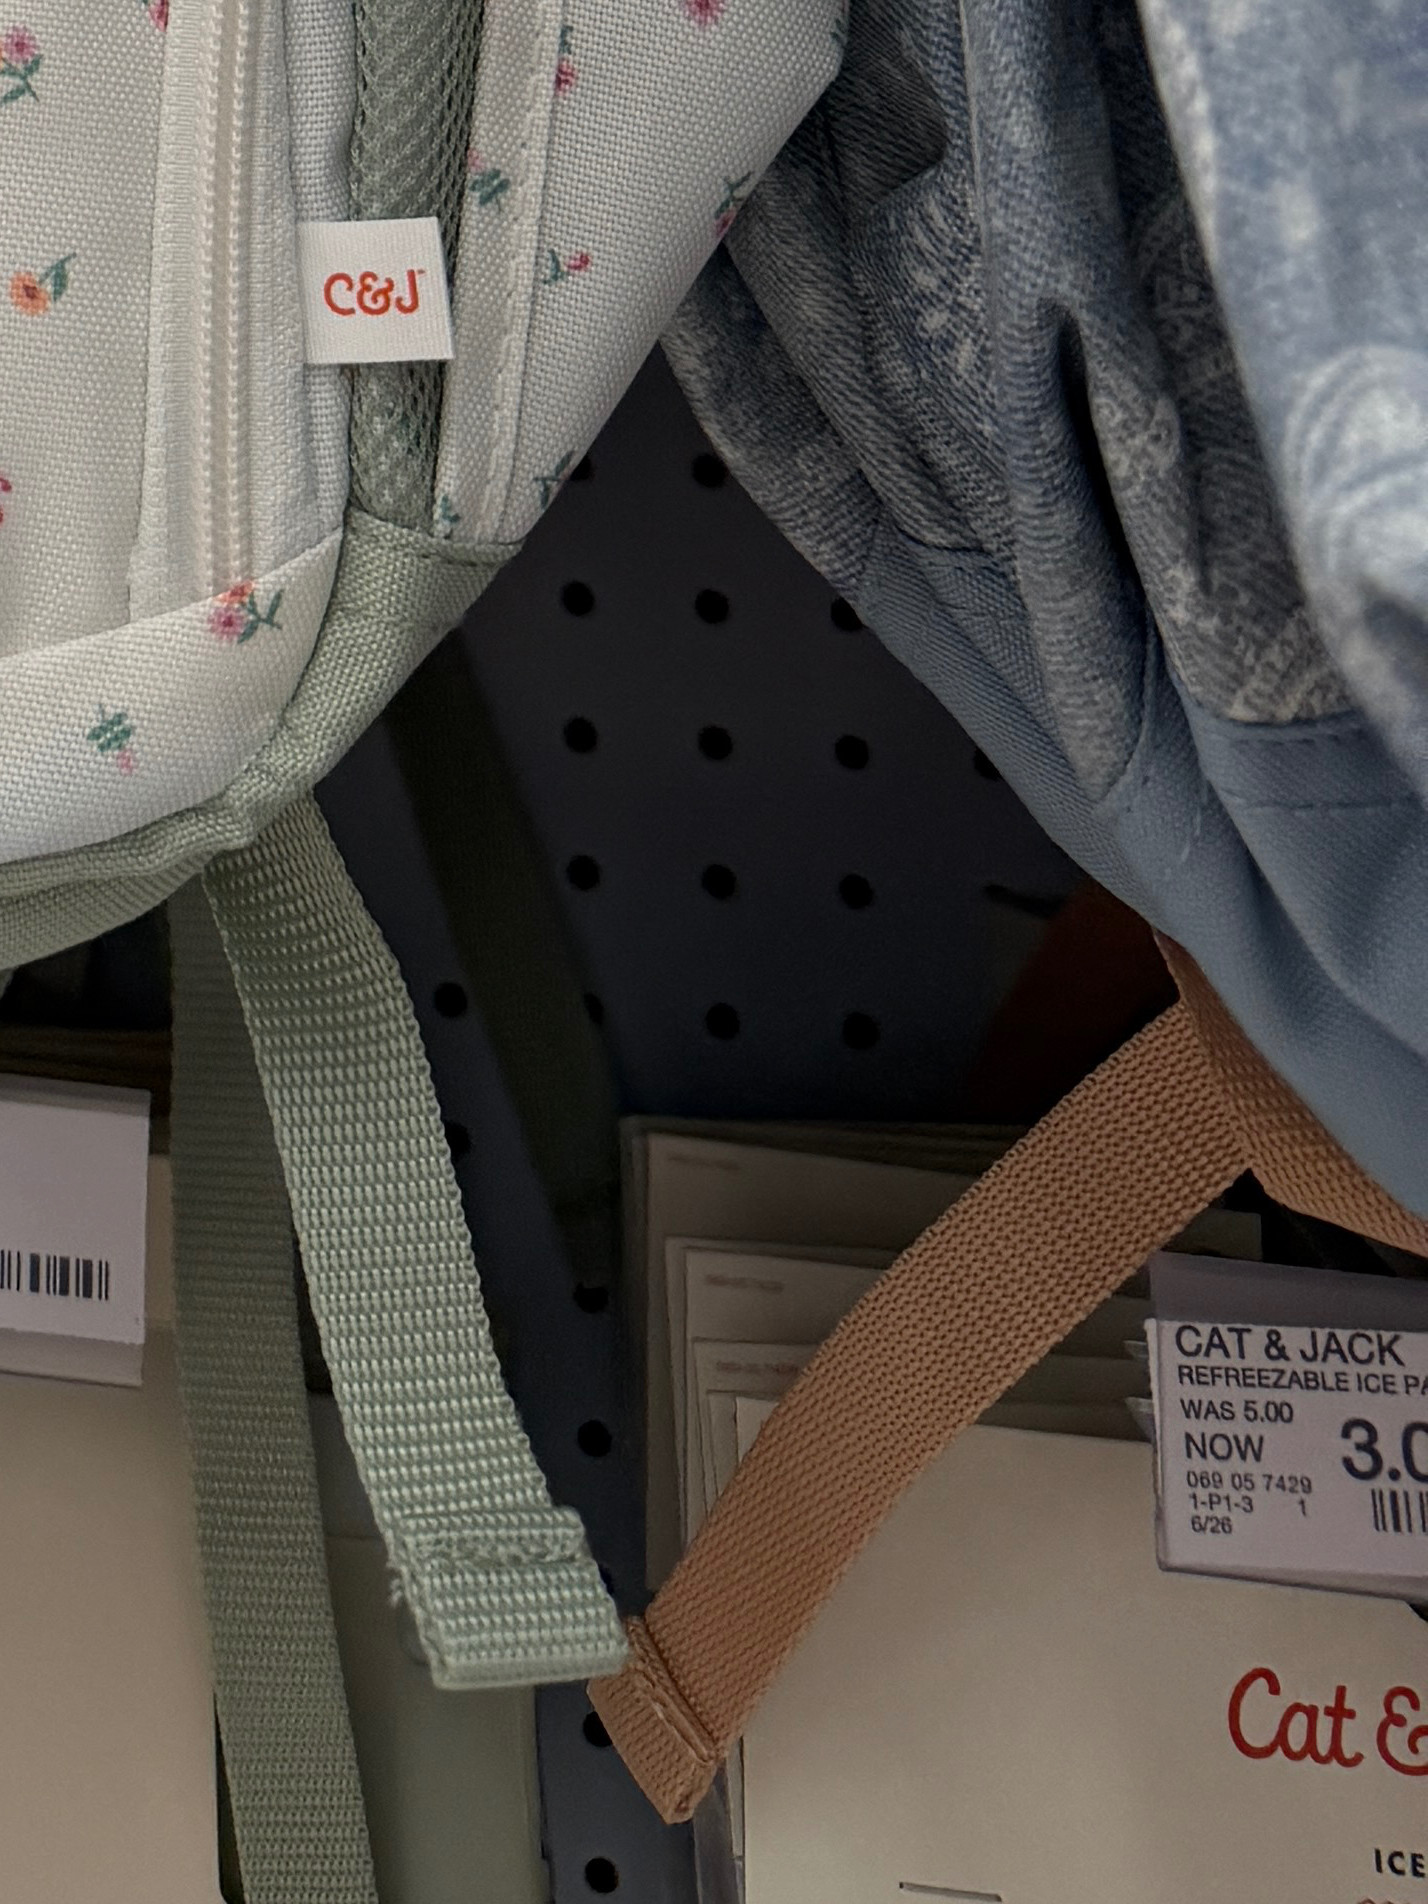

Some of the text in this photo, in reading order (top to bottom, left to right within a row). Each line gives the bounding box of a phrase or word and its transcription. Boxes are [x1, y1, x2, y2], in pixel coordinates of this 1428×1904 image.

[323, 269, 420, 317] C&J
[1175, 1324, 1406, 1367] CAT & JACK
[1178, 1364, 1350, 1393] REFREEZABLE
[1357, 1372, 1398, 1395] ICE
[1180, 1398, 1293, 1423] WAS 5.00
[1184, 1431, 1264, 1463] NOW
[1186, 1471, 1312, 1494] 069 05 7429
[1189, 1492, 1308, 1517] 1-P1-3 1
[1191, 1514, 1233, 1534] 6/26
[1228, 1667, 1365, 1768] Cat
[1373, 1847, 1427, 1879] ICE
